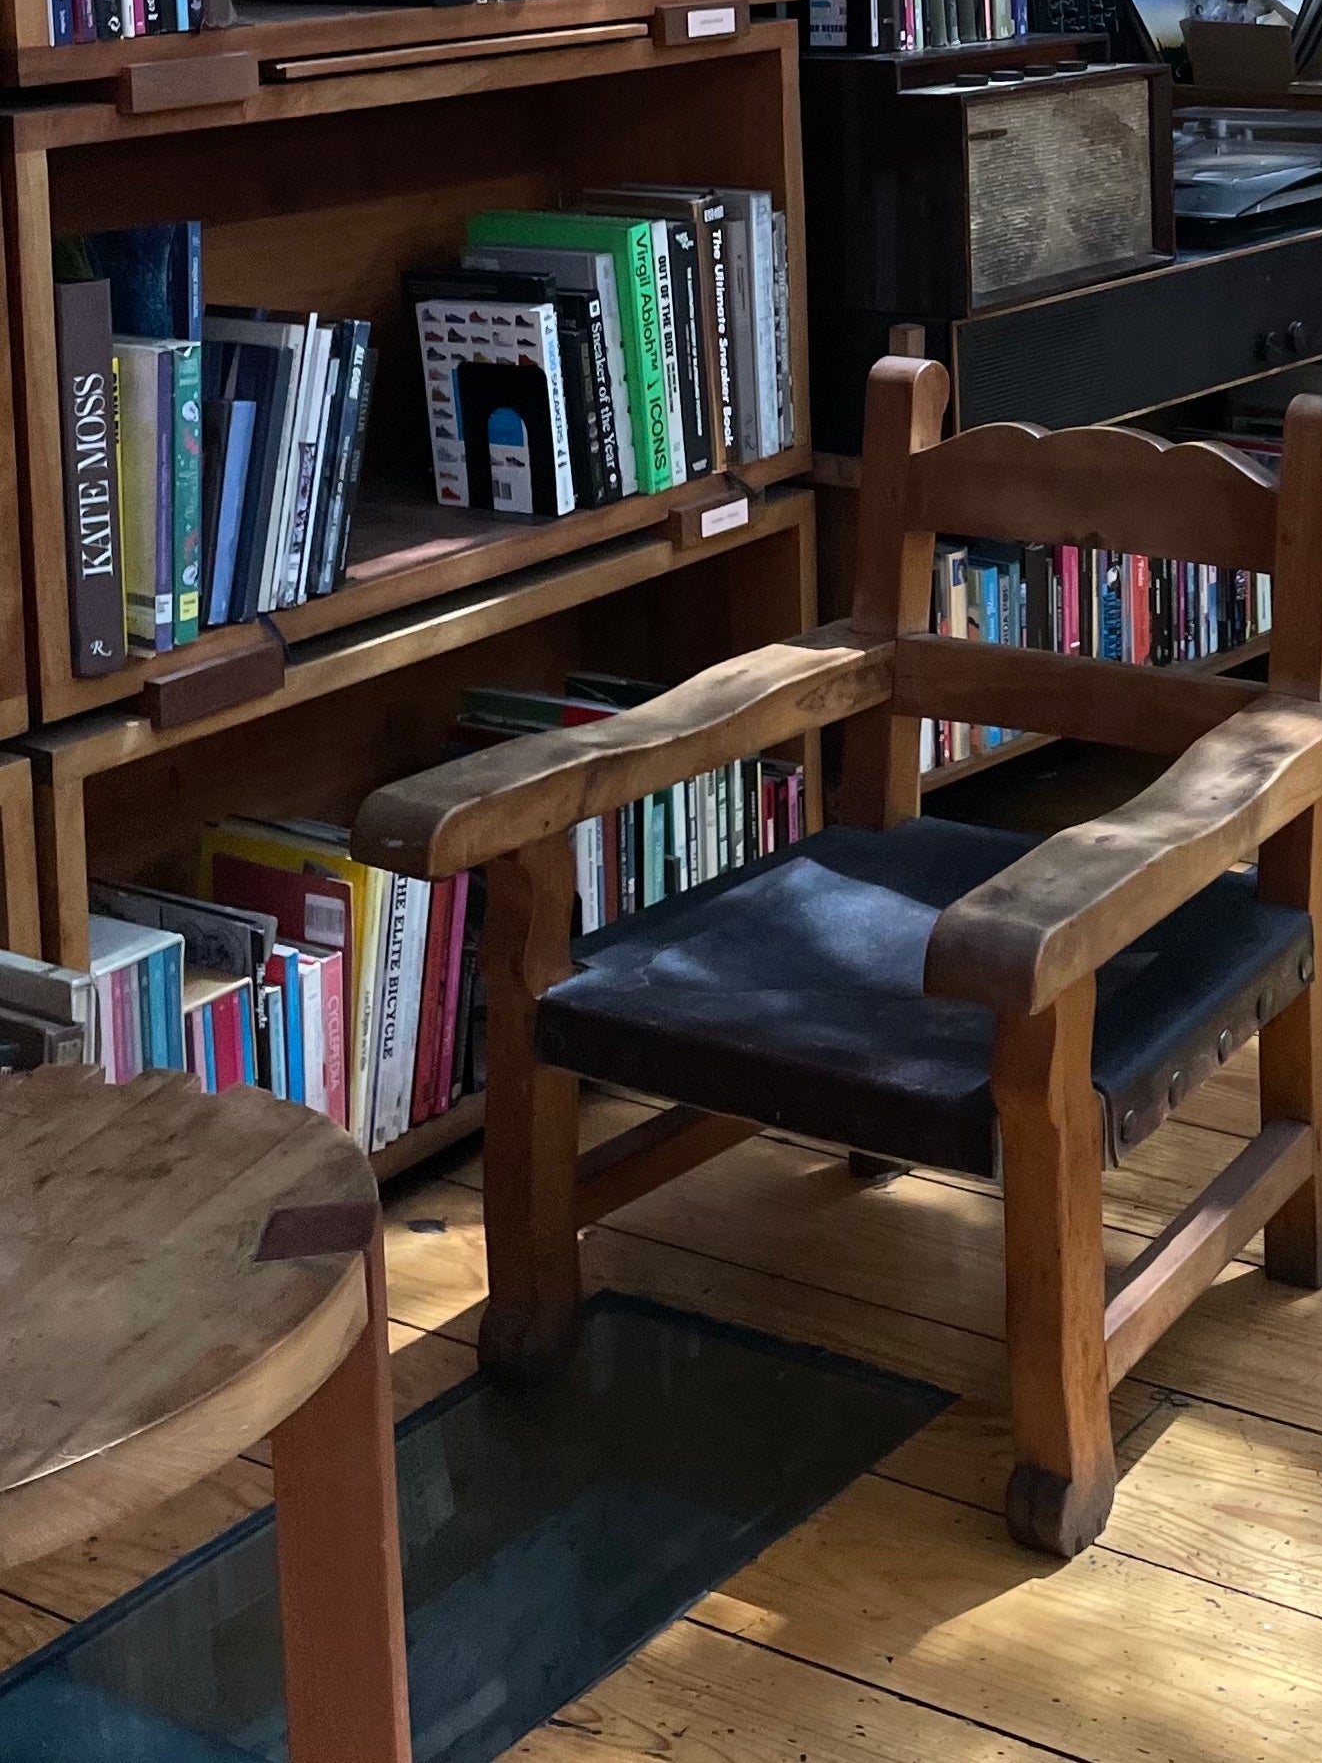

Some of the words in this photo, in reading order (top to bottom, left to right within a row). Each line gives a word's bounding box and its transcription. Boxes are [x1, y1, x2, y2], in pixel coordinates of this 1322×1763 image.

[712, 228, 722, 260] The
[657, 255, 668, 280] OUT
[660, 284, 669, 299] OF
[714, 263, 726, 334] Ultimate
[660, 303, 671, 328] THE
[353, 344, 364, 365] ALL
[591, 320, 605, 384] Sneaker
[636, 233, 650, 287] Virgil
[651, 397, 667, 471] ICONS
[664, 331, 673, 358] BOX
[348, 366, 361, 399] GONE
[718, 337, 730, 403] Sneaker
[552, 372, 563, 443] SNEAKERS
[598, 385, 609, 403] of
[73, 372, 108, 473] MOSS
[600, 405, 611, 435] the
[722, 405, 733, 447] Book
[603, 434, 615, 469] Year
[81, 478, 114, 578] KATE
[90, 639, 112, 656] R
[394, 875, 407, 910] THE
[390, 914, 404, 971] ELITE
[383, 975, 399, 1060] BICYCLE
[326, 994, 341, 1091] CYCLEPEDIA
